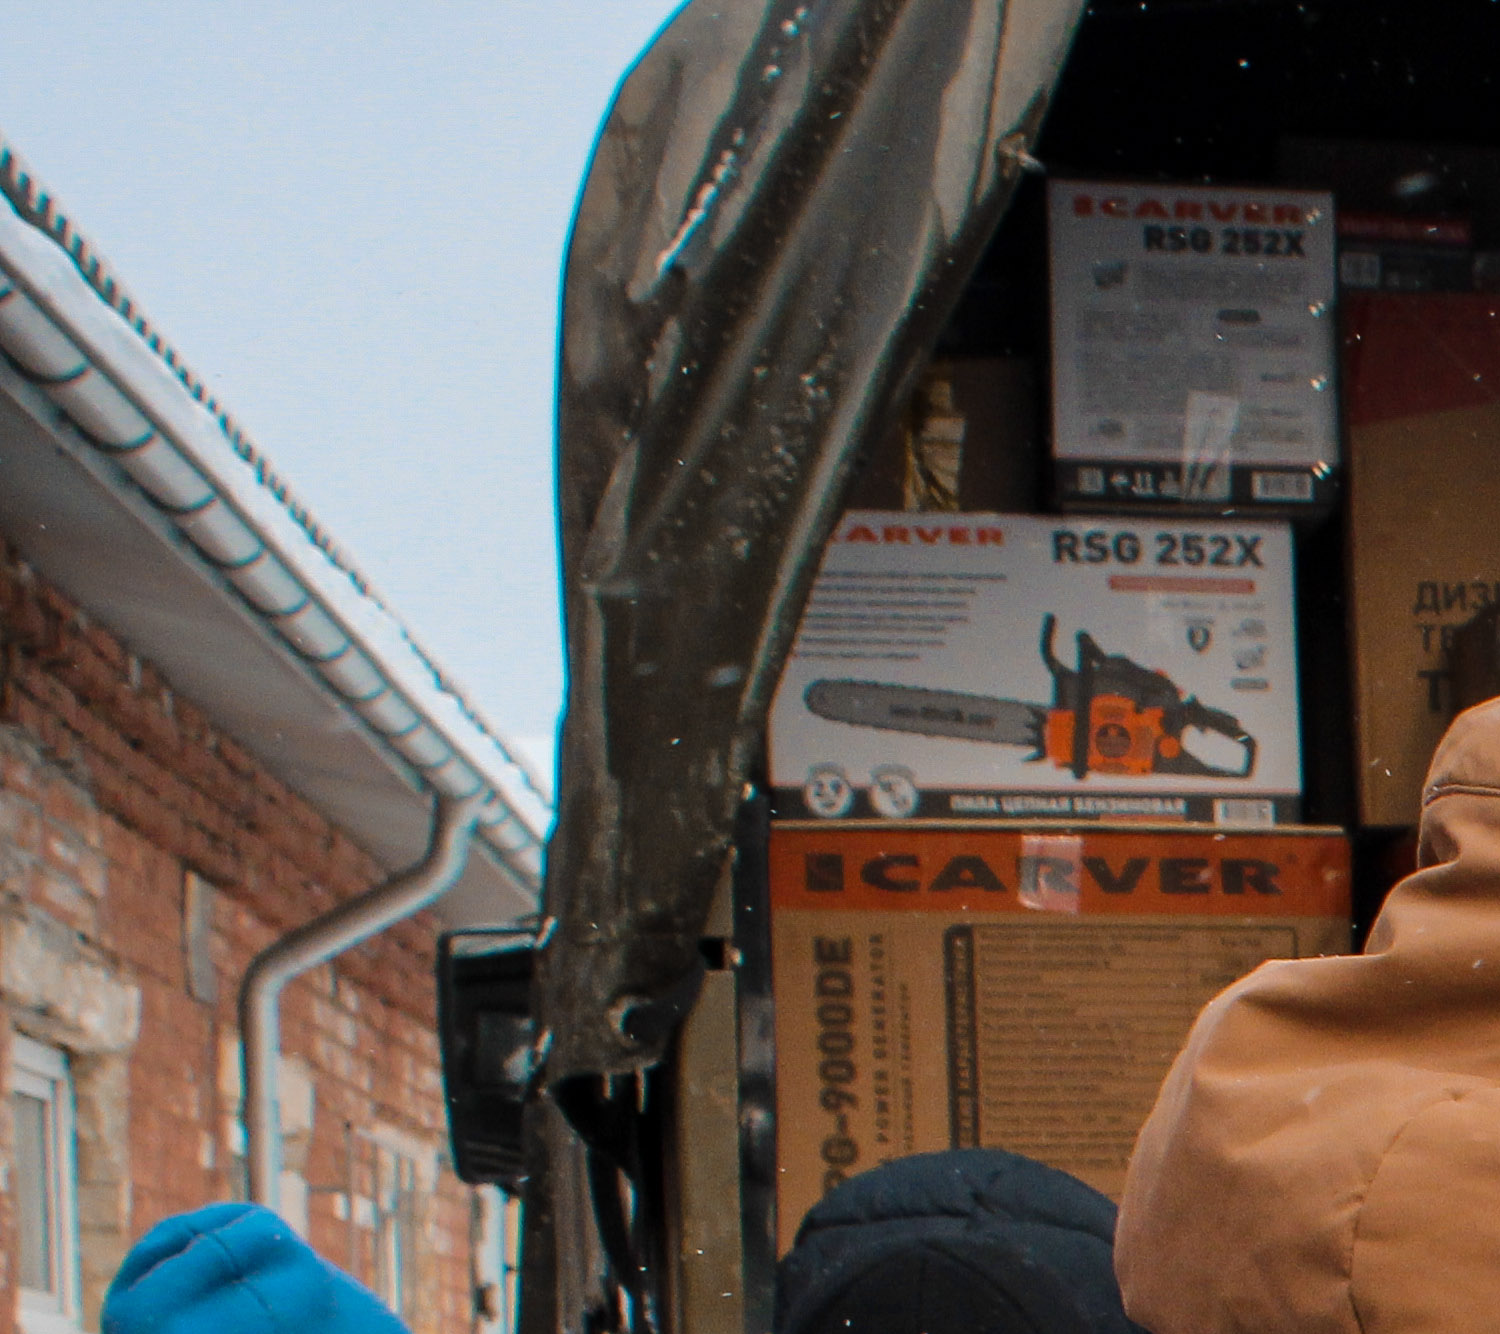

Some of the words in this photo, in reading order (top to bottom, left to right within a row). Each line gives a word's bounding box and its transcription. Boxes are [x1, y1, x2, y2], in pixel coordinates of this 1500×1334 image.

[1099, 197, 1303, 224] CARVER
[1143, 224, 1213, 254] RSG
[1220, 228, 1305, 257] 252X
[1052, 529, 1141, 565] RSG
[1155, 532, 1264, 568] 252X
[860, 854, 1284, 896] CARVER
